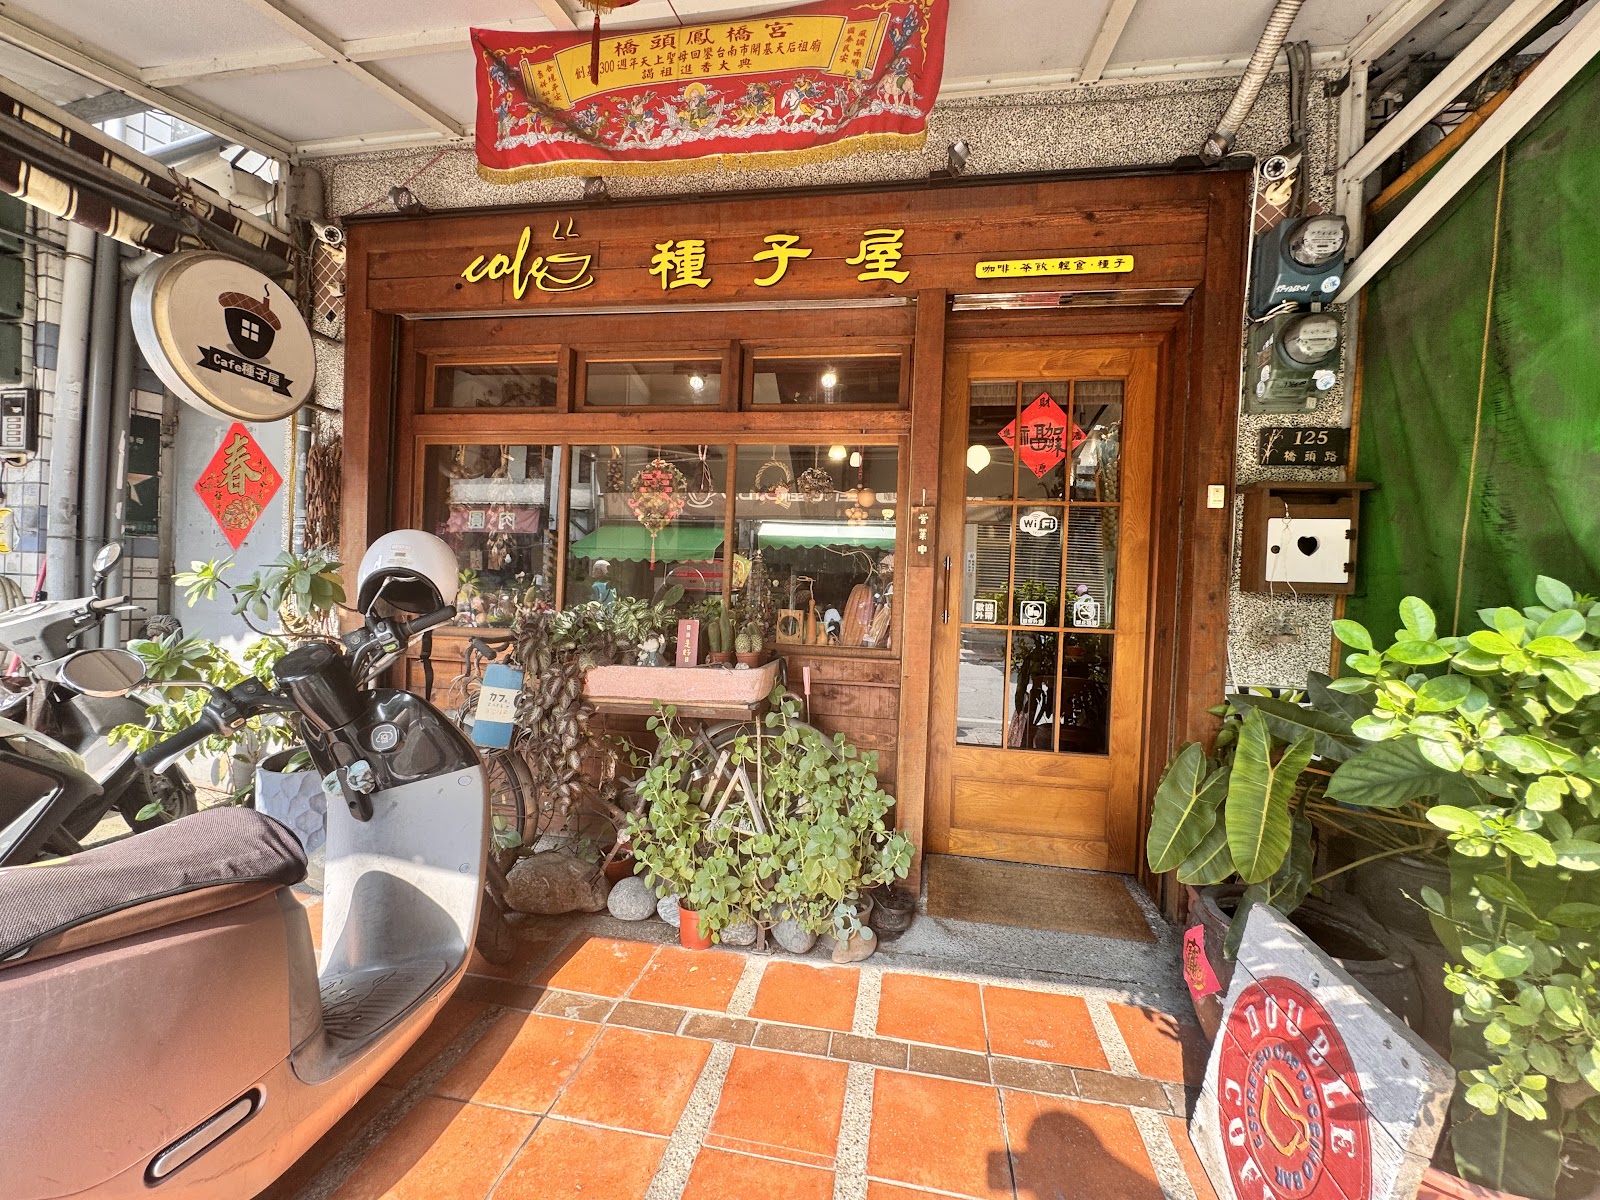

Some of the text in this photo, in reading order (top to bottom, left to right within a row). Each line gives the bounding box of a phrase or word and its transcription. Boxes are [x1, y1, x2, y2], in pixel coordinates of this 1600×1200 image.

[614, 21, 794, 56] 橋頭鳳橋宮
[649, 228, 910, 290] 種子屋
[213, 352, 282, 388] Cafe種子屋
[1293, 430, 1328, 445] 125
[217, 432, 262, 496] 春
[1283, 450, 1338, 463] 橋頭路
[1244, 993, 1356, 1158] DOUBLE
[1274, 1164, 1305, 1190] BAR
